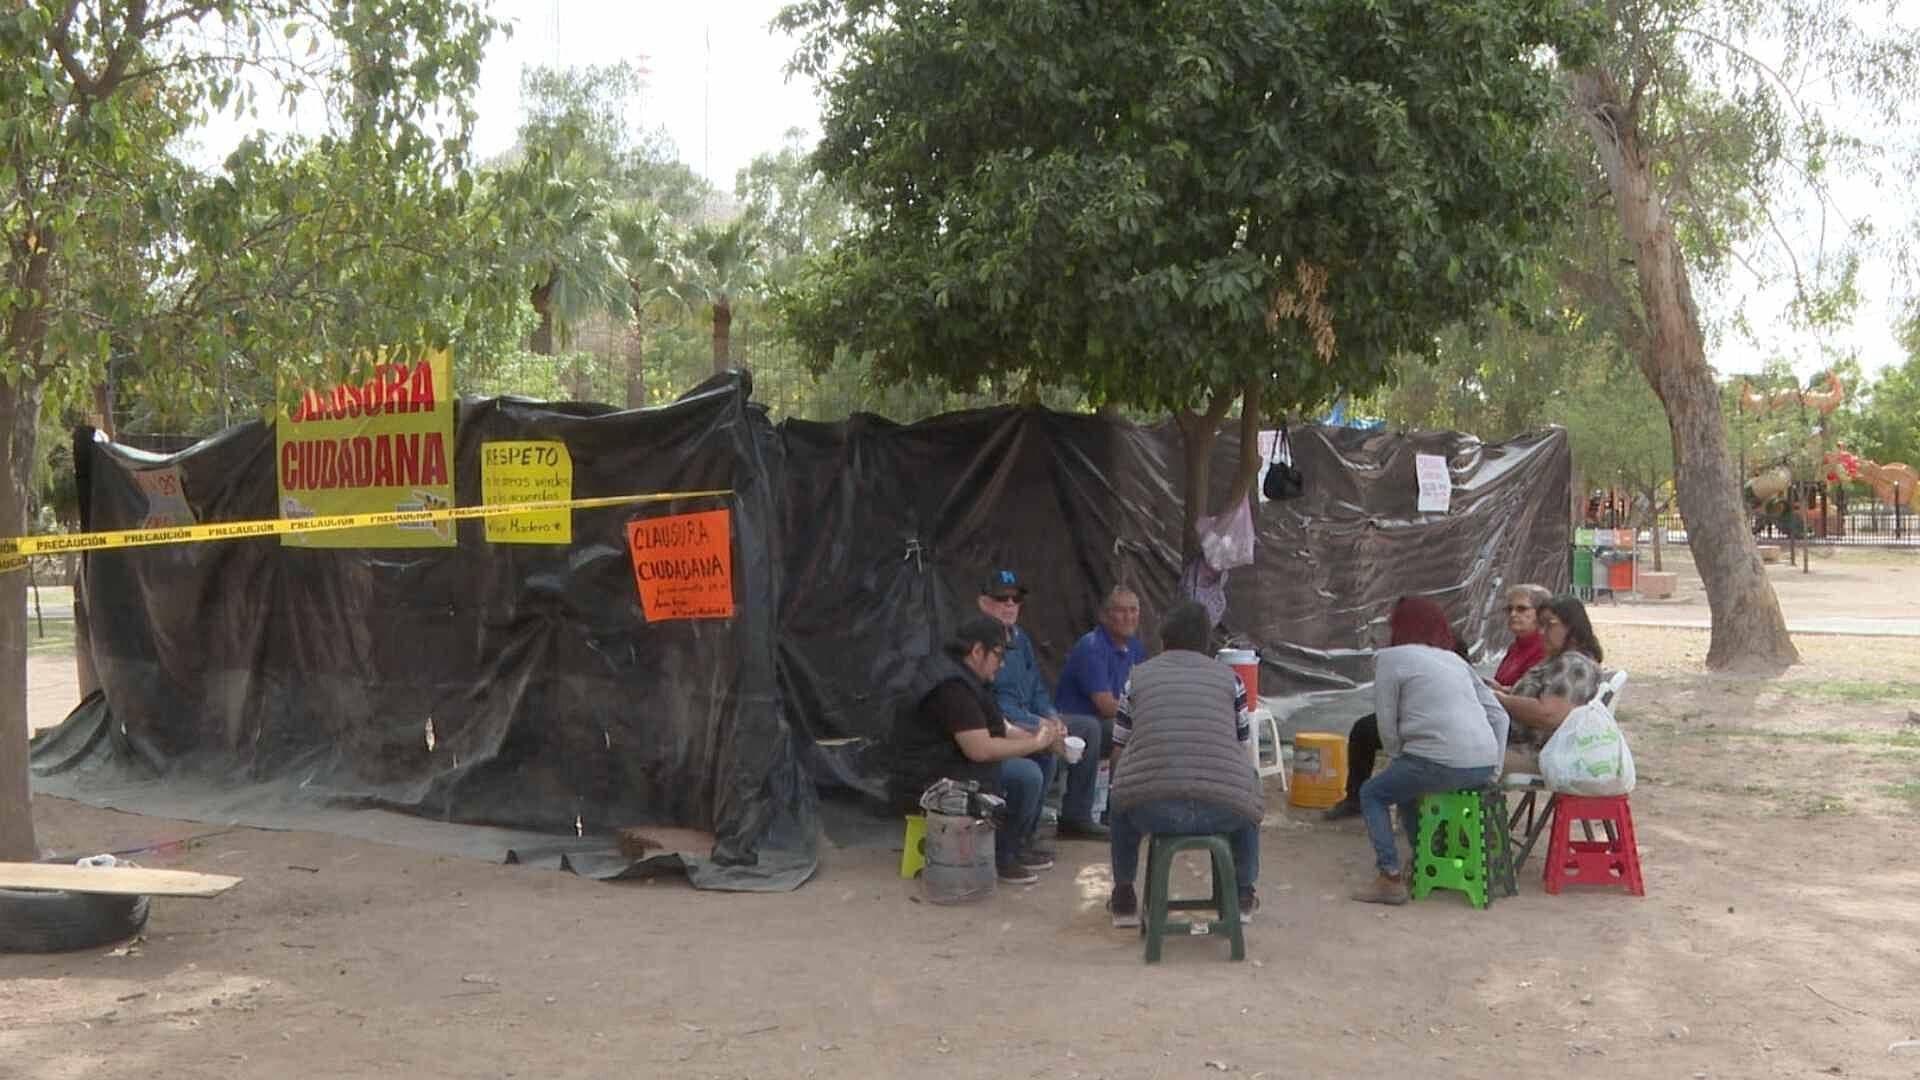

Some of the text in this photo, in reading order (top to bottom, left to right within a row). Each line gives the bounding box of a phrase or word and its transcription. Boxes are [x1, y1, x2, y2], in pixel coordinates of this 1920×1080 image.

[282, 431, 449, 491] CIUDADANA
[486, 446, 559, 467] RESPETO
[36, 536, 107, 551] PRECAUCIÓN
[123, 530, 193, 544] PRECAUCIÓN
[633, 520, 709, 550] CLAUSURA
[638, 554, 725, 581] CIUDADANA
